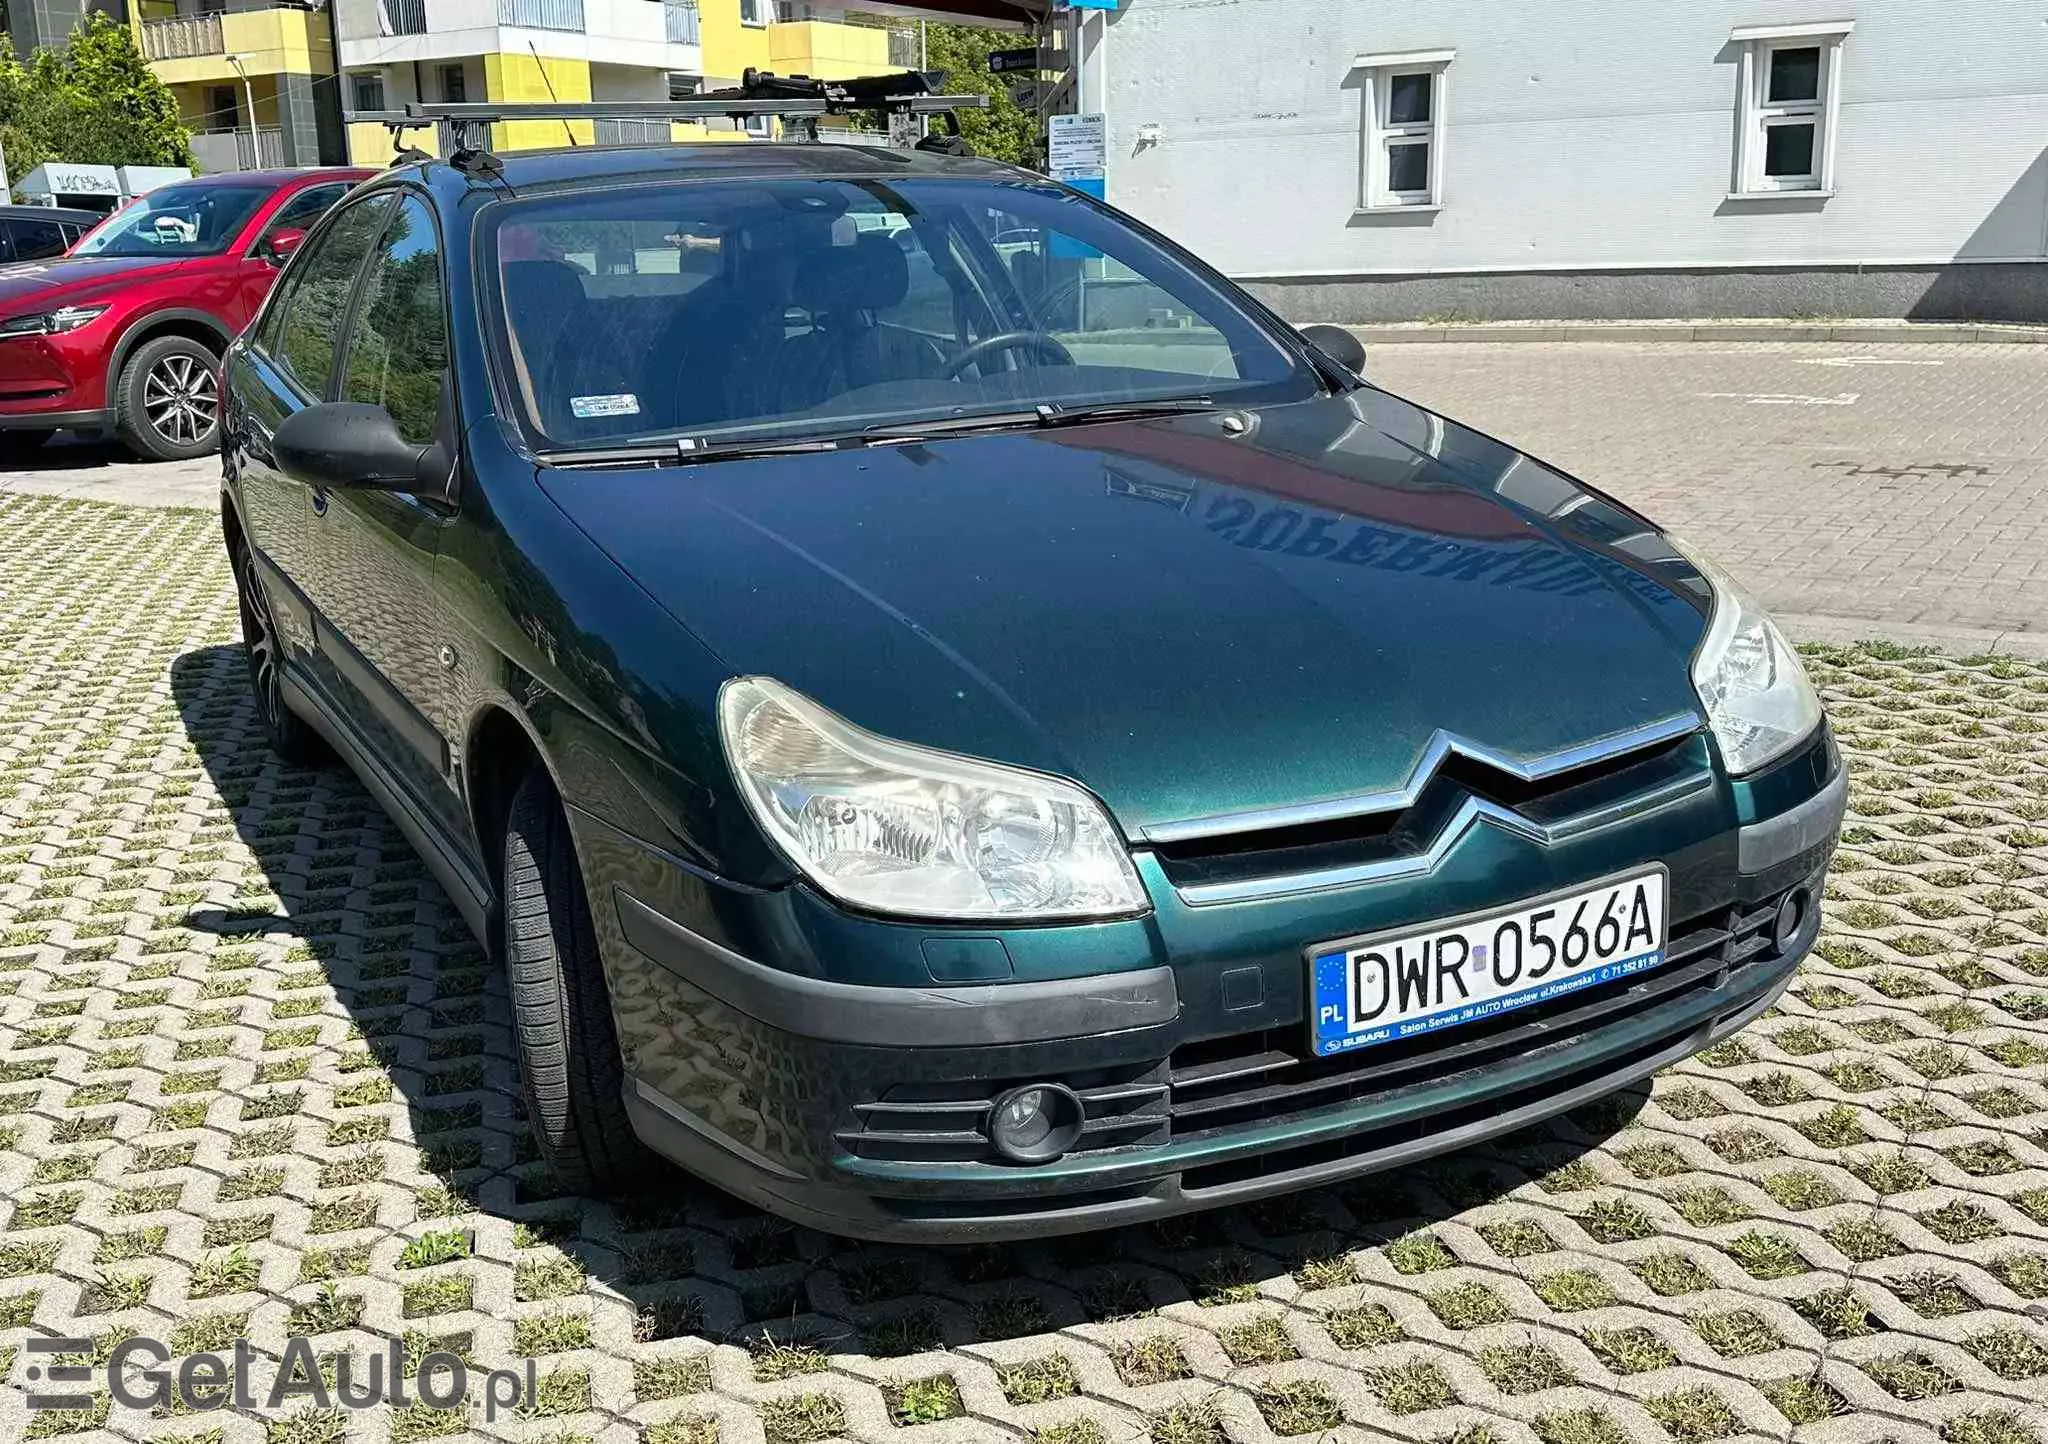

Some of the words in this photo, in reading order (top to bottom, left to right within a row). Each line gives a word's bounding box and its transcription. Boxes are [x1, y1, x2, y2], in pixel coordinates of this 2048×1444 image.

[1353, 933, 1470, 1023] DWR
[1492, 884, 1655, 987] 0566A
[1320, 1006, 1344, 1025] PL
[1399, 1022, 1427, 1036] Salon
[1429, 1014, 1459, 1028] Serwis
[1460, 1008, 1474, 1020] JM
[1475, 1001, 1501, 1016] AUTO
[1612, 967, 1621, 977] 71
[1622, 961, 1637, 973] 352
[1342, 1029, 1390, 1048] SUBARU
